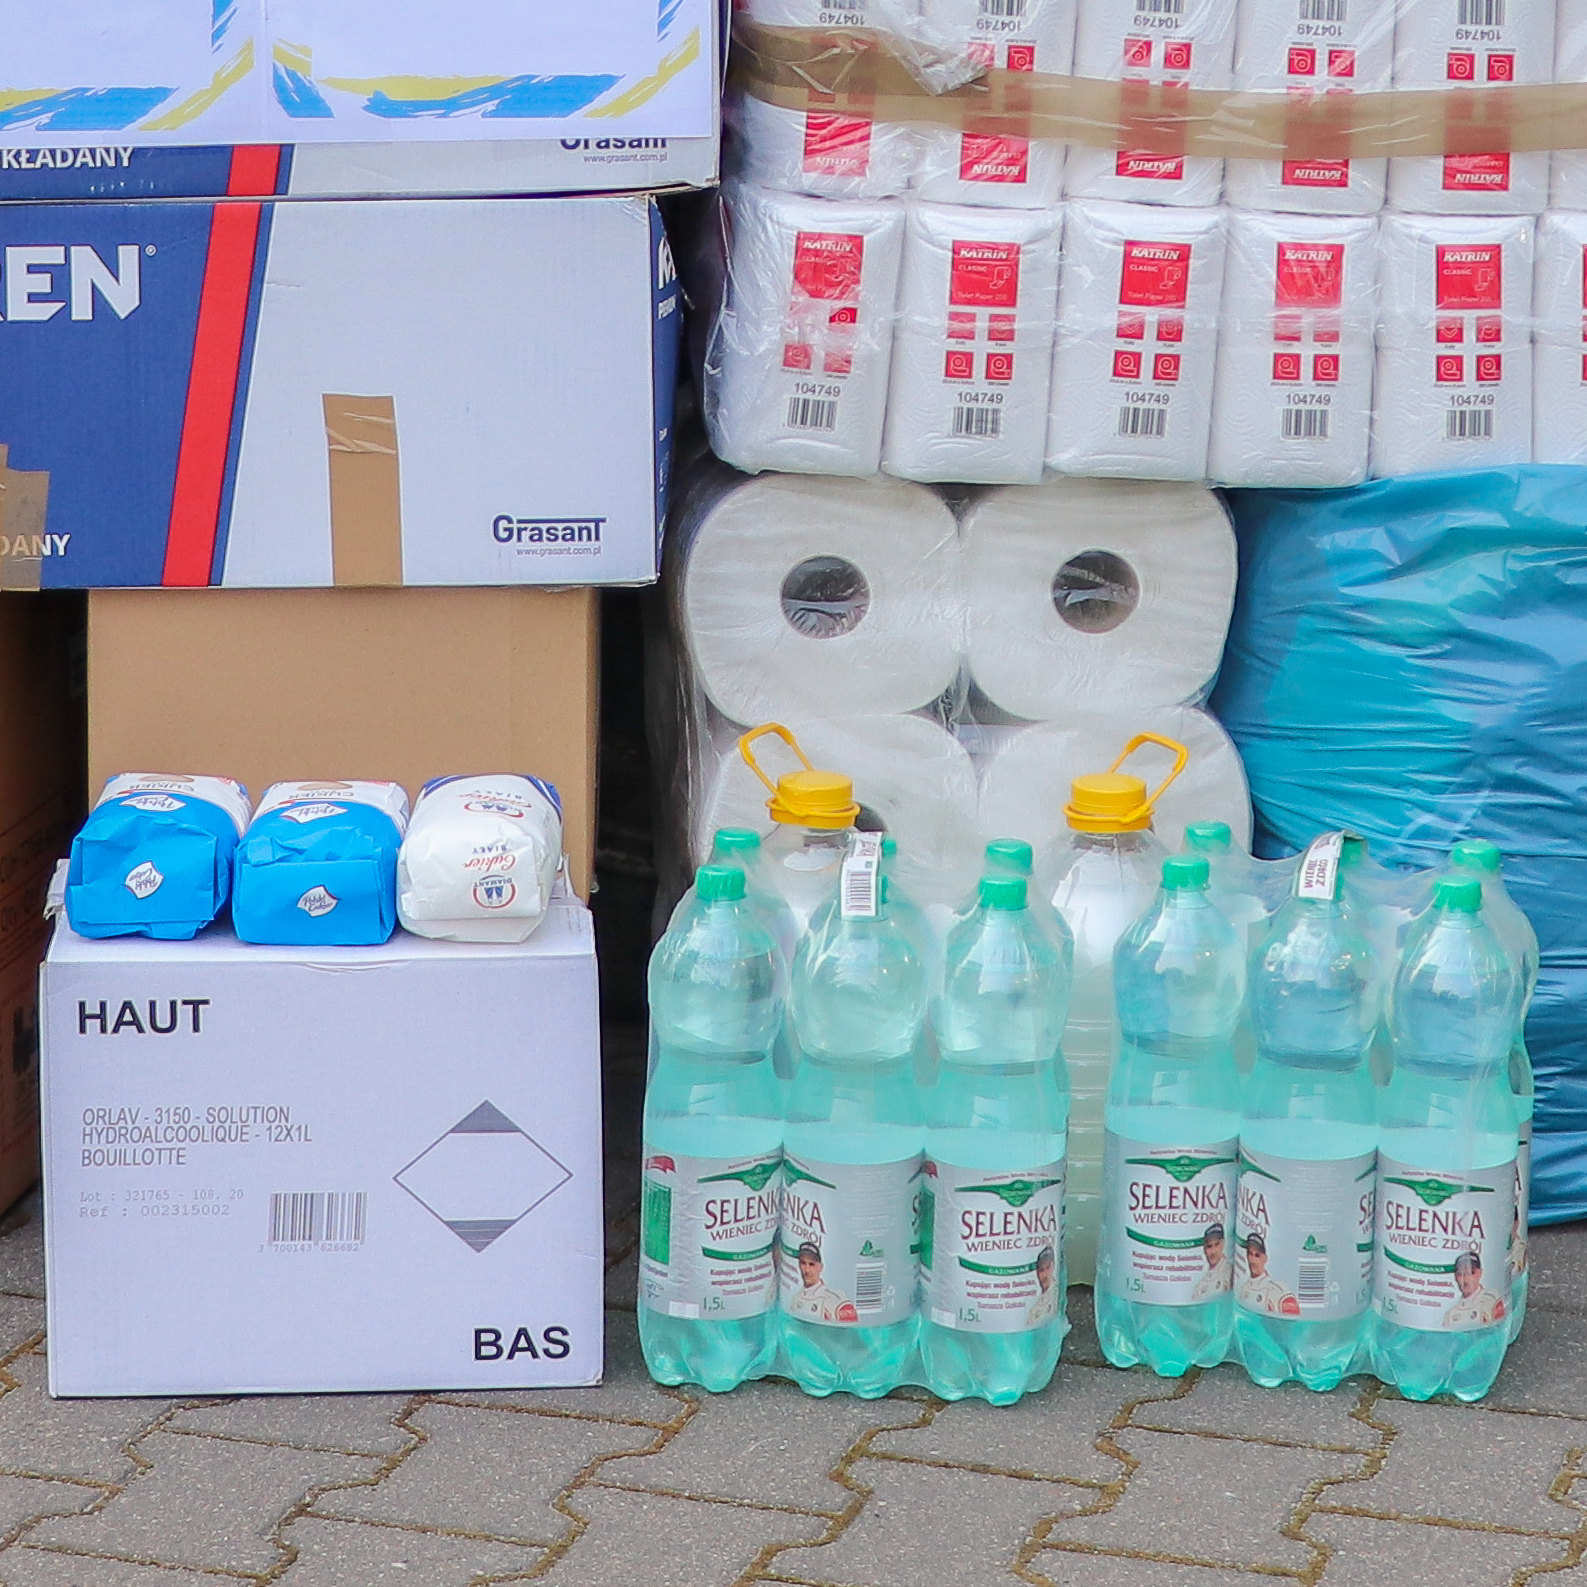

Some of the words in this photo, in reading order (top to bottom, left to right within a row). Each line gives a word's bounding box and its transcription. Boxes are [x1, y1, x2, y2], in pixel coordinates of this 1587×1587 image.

[819, 12, 866, 25] 104749
[976, 19, 1023, 31] 104749
[1134, 15, 1181, 29] 104749
[1297, 24, 1343, 36] 104749
[1456, 29, 1502, 41] 104749
[971, 163, 1020, 176] KATRIN
[1128, 160, 1176, 172] KATRIN
[1294, 168, 1342, 180] KATRIN
[1455, 173, 1503, 184] KATRIN
[803, 240, 852, 252] KATRIN
[959, 248, 1009, 260] KATRIN
[1131, 248, 1180, 260] KATRIN
[1284, 250, 1333, 261] KATRIN
[1444, 252, 1492, 262] KATRIN
[1130, 264, 1159, 272] CLASSIC
[794, 382, 841, 397] 104749
[956, 392, 1003, 405] 104749
[1124, 392, 1170, 404] 104749
[1285, 393, 1331, 405] 104749
[1450, 394, 1494, 406] 104749
[516, 546, 602, 557] www.grasant.com.pl
[463, 854, 516, 873] Cukier
[77, 998, 211, 1035] HAUT
[82, 1107, 140, 1126] ORLAV
[154, 1106, 191, 1124] 3150
[205, 1105, 291, 1125] SOLUTION
[81, 1124, 251, 1145] HYDROALCOOLIQUE
[265, 1124, 312, 1142] 12X1L
[81, 1147, 187, 1167] BOUILLOTTE
[79, 1190, 101, 1203] Lot
[125, 1190, 170, 1201] 321765
[229, 1189, 244, 1200] 20
[1129, 1181, 1229, 1211] SELENKA
[80, 1206, 109, 1218] Ref
[141, 1204, 230, 1217] 002315002
[704, 1187, 780, 1230] SELENK
[961, 1204, 1057, 1240] SELENKA
[1133, 1212, 1188, 1224] WIENIEC
[1385, 1200, 1486, 1239] SELENKA
[710, 1222, 761, 1241] WIENIEC
[966, 1239, 1023, 1252] WIENIEC
[1388, 1233, 1438, 1248] WIENIEC
[473, 1326, 571, 1362] BAS
